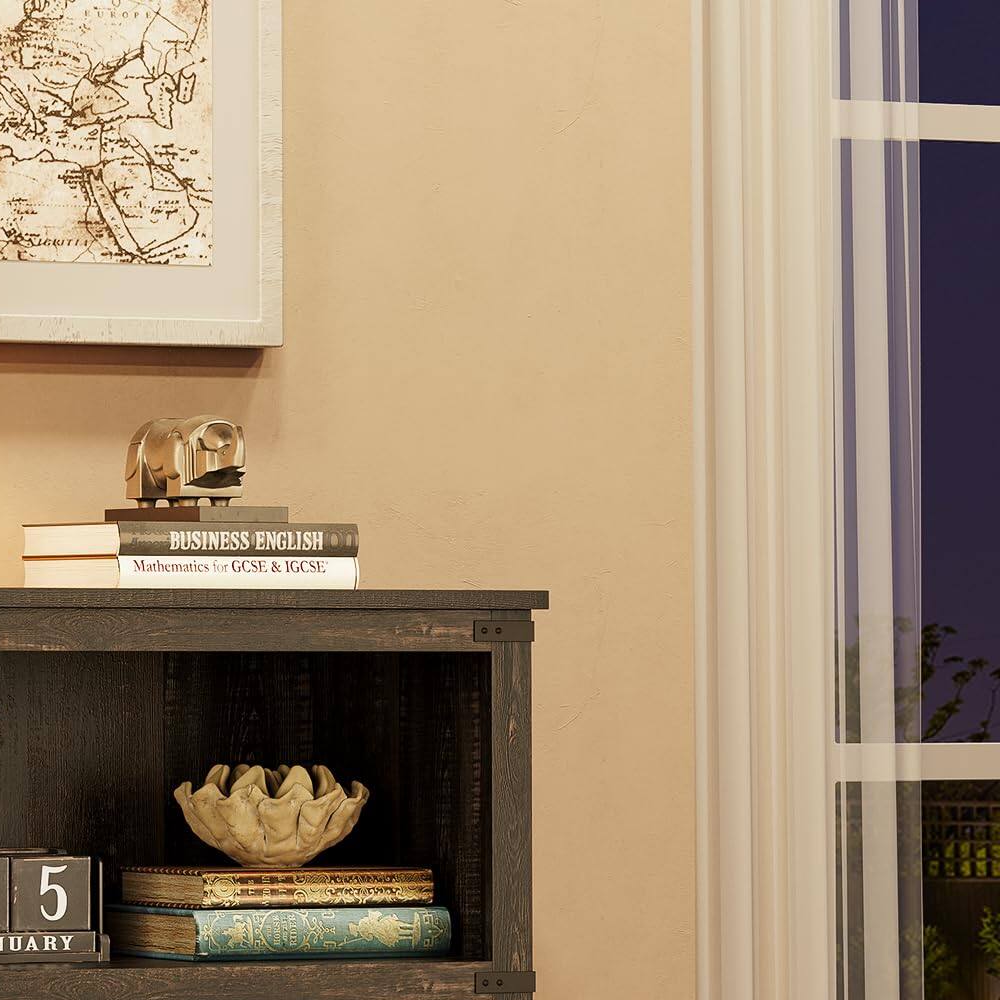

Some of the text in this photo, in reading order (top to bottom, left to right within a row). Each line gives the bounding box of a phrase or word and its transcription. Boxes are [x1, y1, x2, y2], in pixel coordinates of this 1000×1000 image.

[169, 530, 250, 551] BUSINESS
[255, 531, 324, 551] ENGLISH
[133, 559, 210, 573] Mathematics
[213, 559, 229, 573] for
[231, 559, 267, 573] GCSE
[271, 560, 282, 573] &
